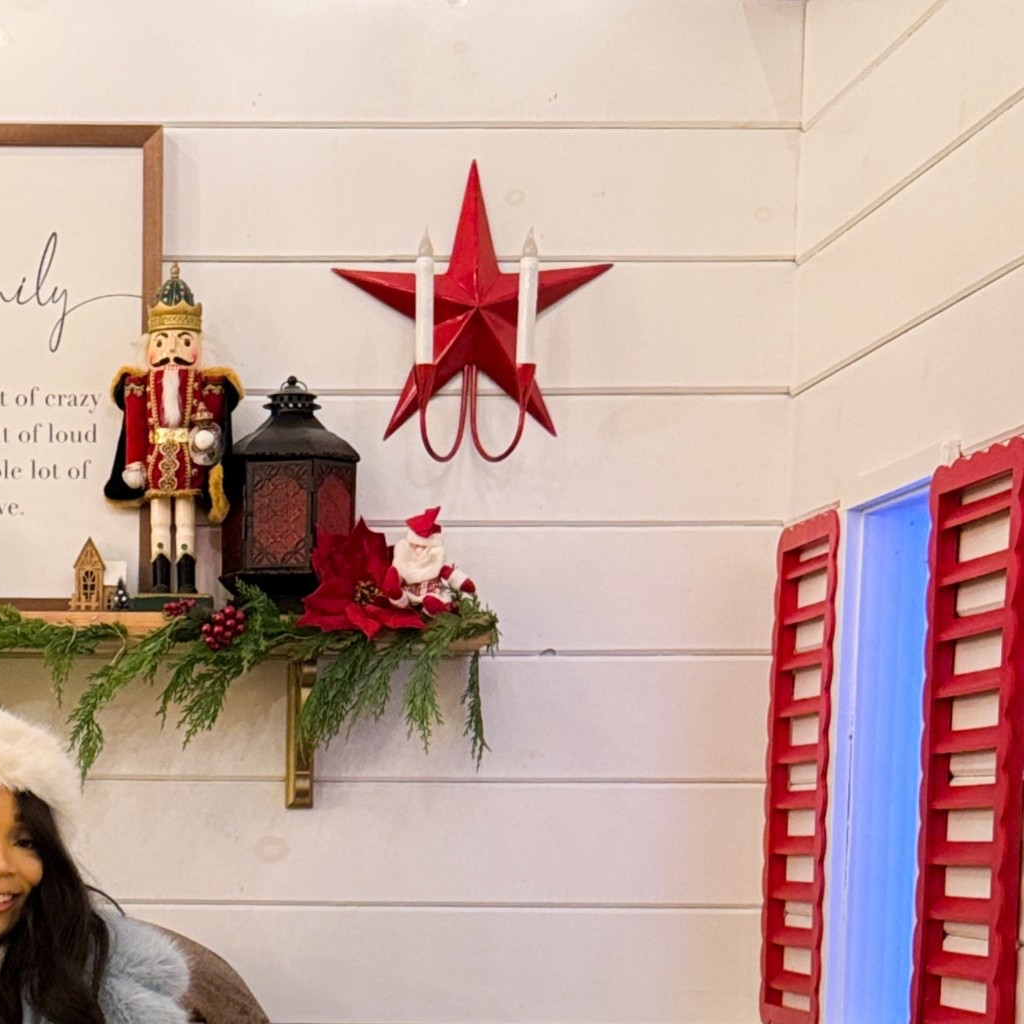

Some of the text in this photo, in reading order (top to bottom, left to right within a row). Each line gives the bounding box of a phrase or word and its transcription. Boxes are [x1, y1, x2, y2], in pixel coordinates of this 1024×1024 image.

[14, 386, 40, 407] of
[44, 393, 102, 414] crazy
[17, 422, 43, 443] of
[48, 422, 97, 443] loud
[30, 459, 60, 480] lot
[67, 459, 92, 480] of
